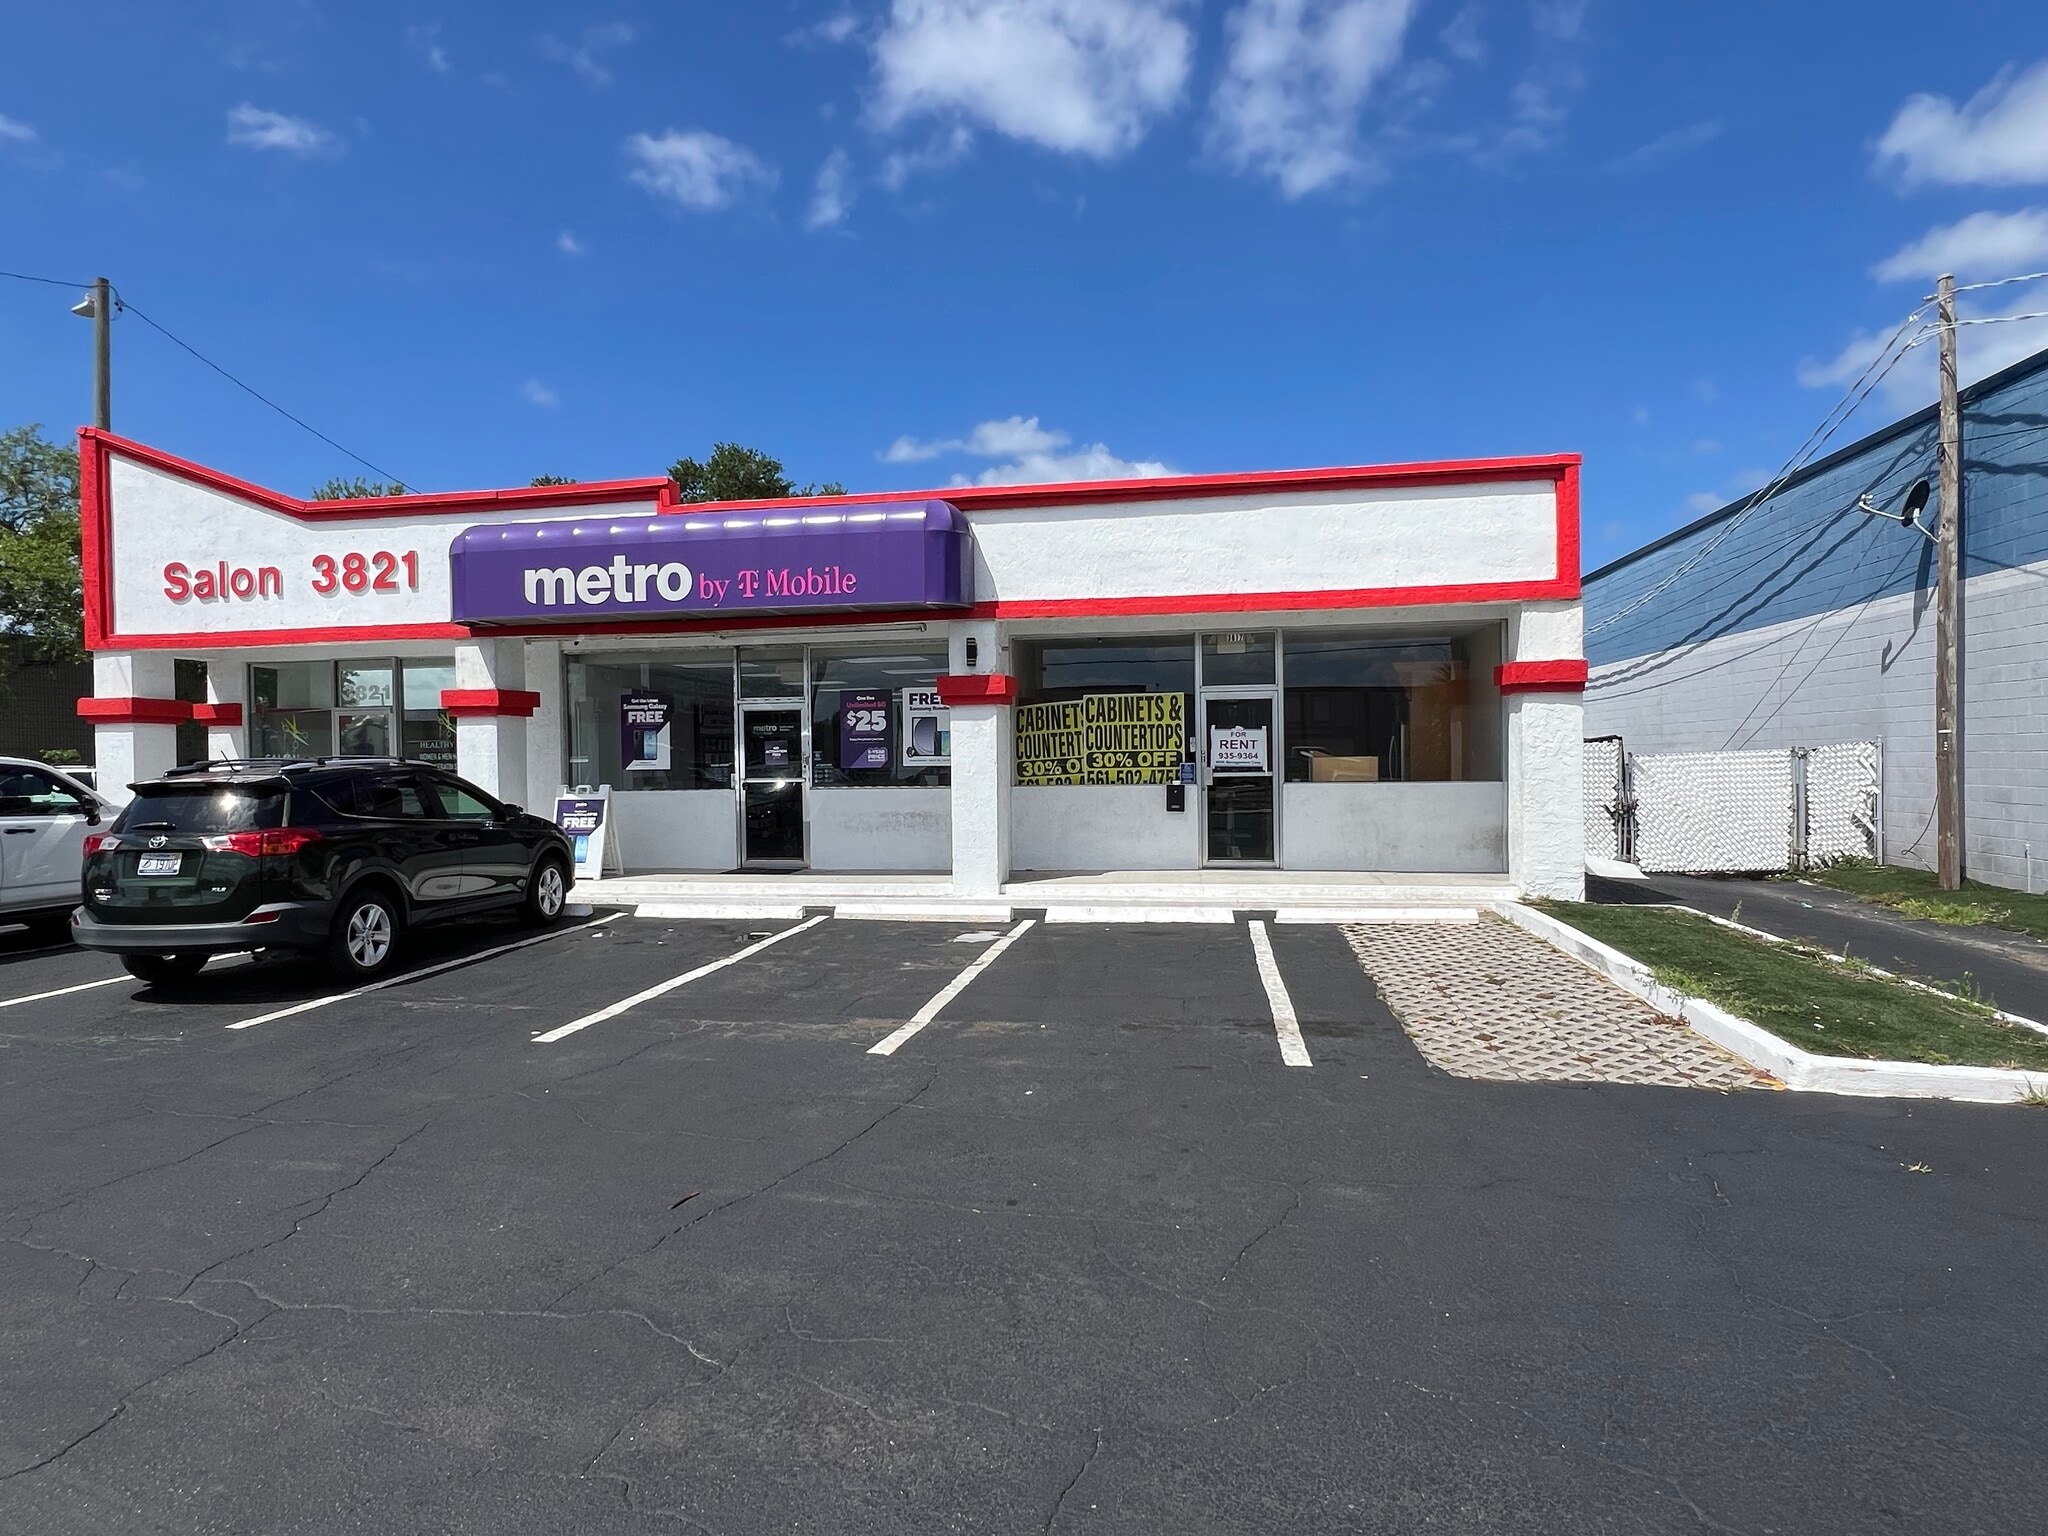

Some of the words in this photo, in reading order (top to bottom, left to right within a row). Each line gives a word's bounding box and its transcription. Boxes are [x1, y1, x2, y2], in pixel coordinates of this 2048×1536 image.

[163, 560, 283, 602] Salon
[311, 550, 418, 593] 3821
[524, 554, 693, 605] metro
[699, 572, 730, 607] by
[342, 682, 391, 701] 3821
[909, 692, 942, 705] FRE
[628, 711, 664, 723] FREE
[1085, 695, 1164, 723] CABINETS
[1168, 695, 1182, 721] &
[847, 710, 887, 731] $25
[420, 741, 455, 749] HEALTHY
[1016, 731, 1084, 760] COUNTERT
[1085, 723, 1183, 751] COUNTERTOPS
[1219, 739, 1258, 750] RENT
[1092, 752, 1134, 768] 30%
[1137, 751, 1178, 767] OFF
[1218, 752, 1259, 760] 935-9364
[1022, 760, 1063, 777] 30%
[563, 816, 597, 828] FREE
